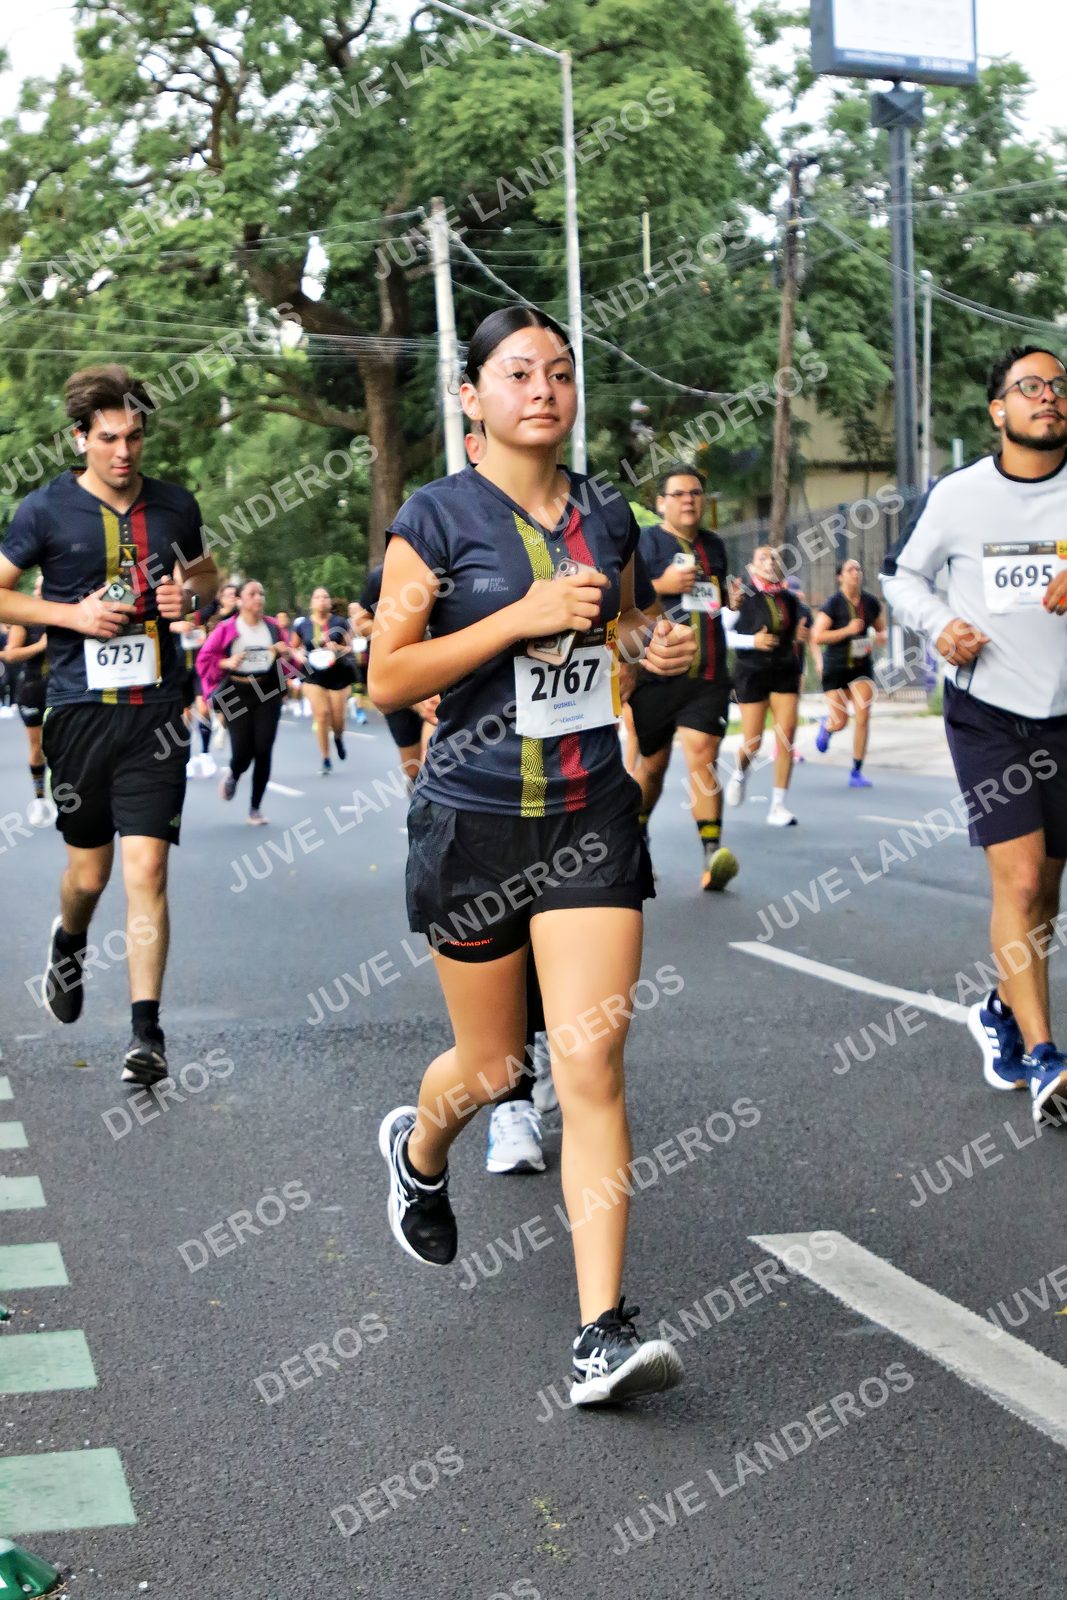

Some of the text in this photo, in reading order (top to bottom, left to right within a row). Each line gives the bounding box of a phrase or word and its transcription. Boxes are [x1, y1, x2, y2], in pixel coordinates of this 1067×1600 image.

[995, 564, 1053, 588] 6695
[97, 643, 145, 666] 6737
[530, 658, 600, 701] 2767
